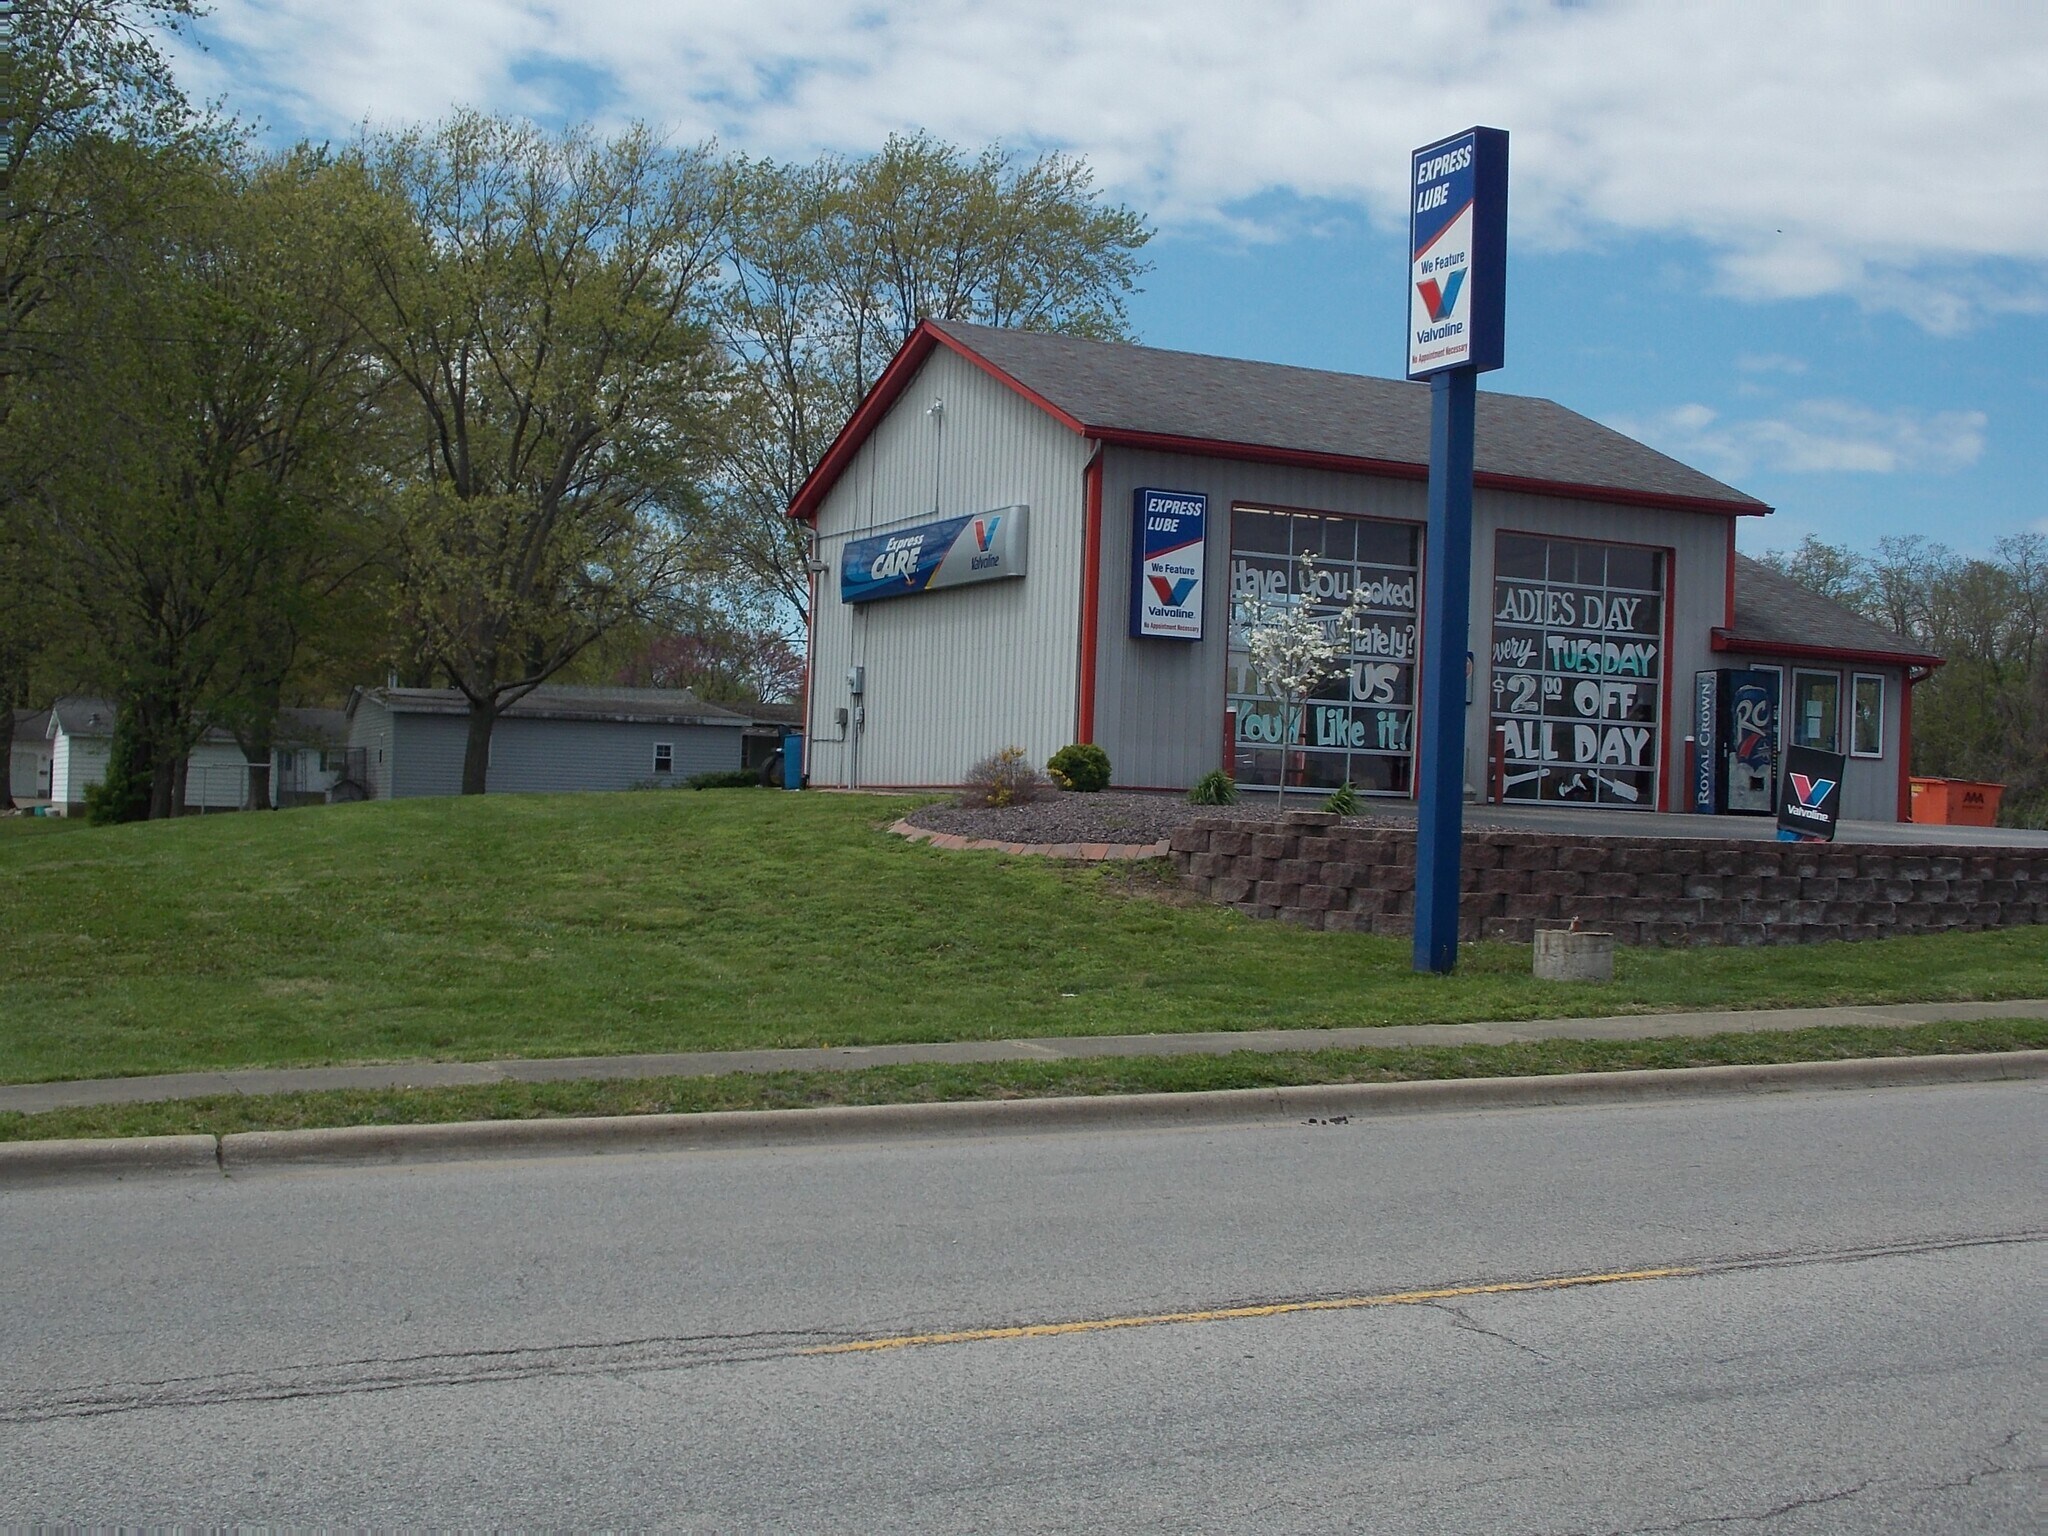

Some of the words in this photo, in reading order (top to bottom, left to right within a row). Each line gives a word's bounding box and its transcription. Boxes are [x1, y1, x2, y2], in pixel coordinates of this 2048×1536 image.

[1417, 144, 1472, 185] EXPRESS
[1416, 182, 1450, 214] LUBE
[1420, 258, 1434, 275] We
[1435, 251, 1465, 271] Feature
[1416, 321, 1464, 344] Valvoline
[1412, 354, 1418, 364] No
[1418, 349, 1445, 364] Appointment
[1445, 344, 1468, 356] Necessary
[1148, 499, 1202, 516] EXPRESS
[1147, 517, 1179, 532] LUBE
[885, 534, 924, 552] Express
[871, 547, 921, 582] CARE
[971, 556, 1000, 571] Valvoline
[1151, 562, 1164, 573] We
[1165, 564, 1195, 575] Feature
[1232, 560, 1287, 599] Have
[1148, 606, 1194, 619] Valvoline
[1150, 622, 1177, 631] Appointment
[1177, 624, 1199, 633] Necessary
[1582, 595, 1642, 631] DAY
[1547, 635, 1658, 677] TUESDAY
[1352, 663, 1399, 704] US
[1573, 680, 1637, 719] OFF
[1316, 706, 1365, 747] Like
[1377, 710, 1412, 750] it!
[1699, 683, 1711, 747] CROWN
[1736, 699, 1769, 753] RC
[1504, 720, 1558, 761] ALL
[1574, 724, 1650, 766] DAY
[1697, 749, 1710, 804] ROYAL
[1787, 803, 1830, 823] Valvoline
